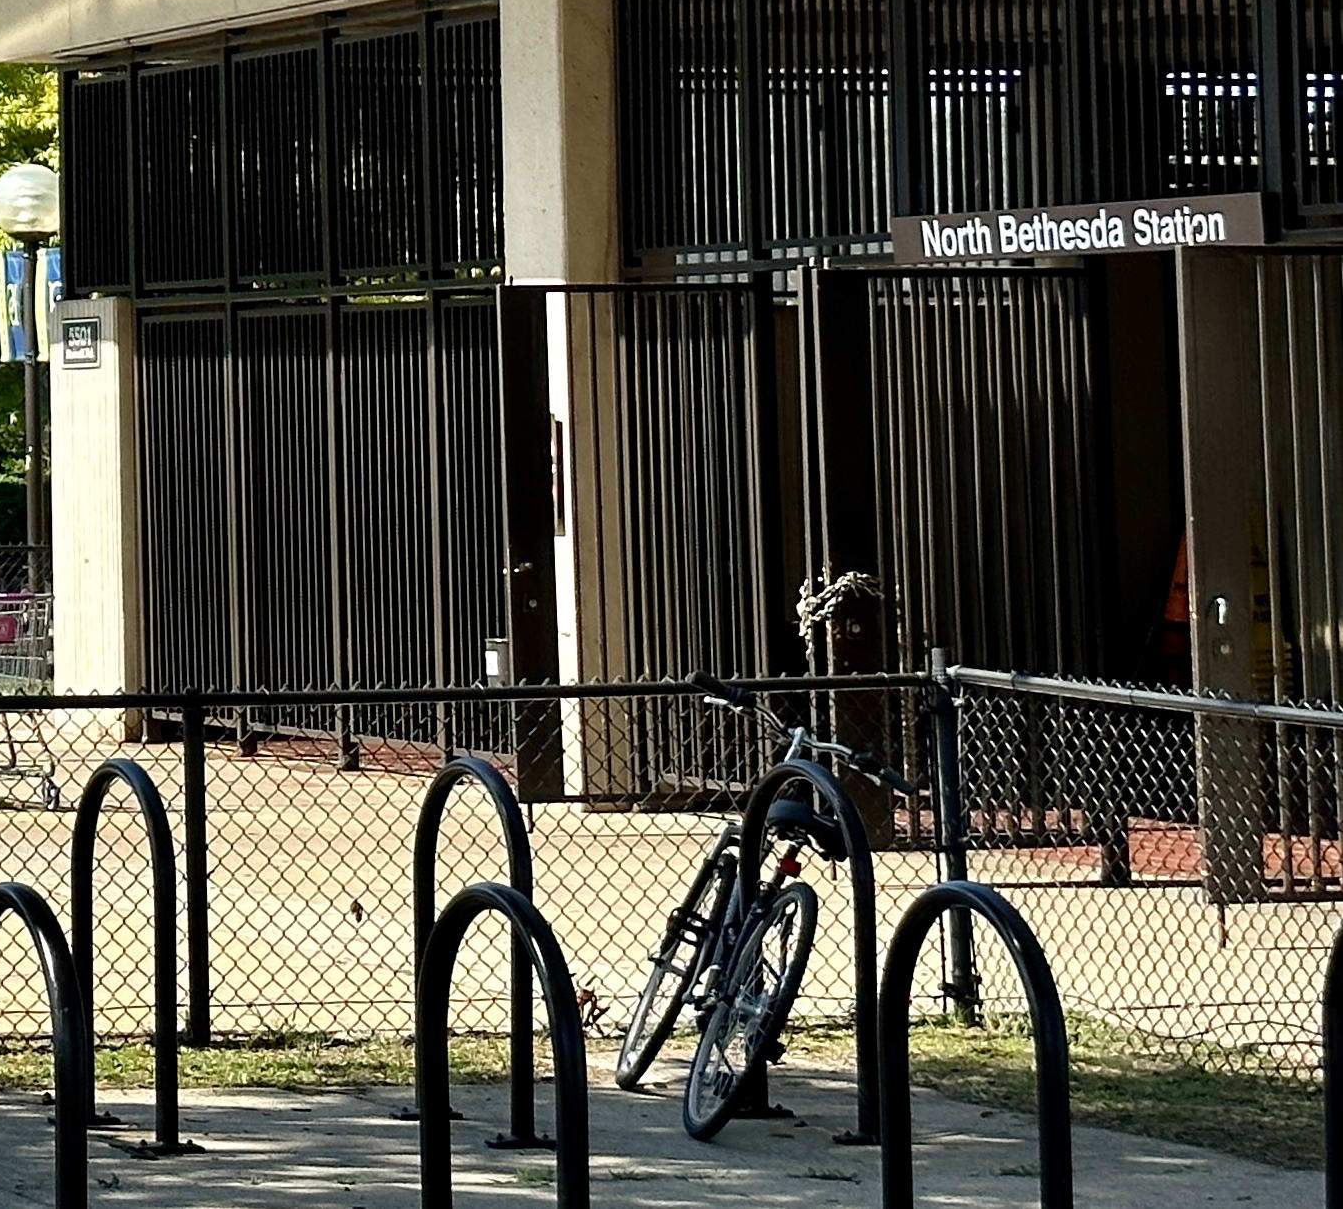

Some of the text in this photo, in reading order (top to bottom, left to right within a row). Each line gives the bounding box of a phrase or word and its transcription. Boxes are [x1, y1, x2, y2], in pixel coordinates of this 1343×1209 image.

[920, 206, 1226, 257] North Bethesda Station
